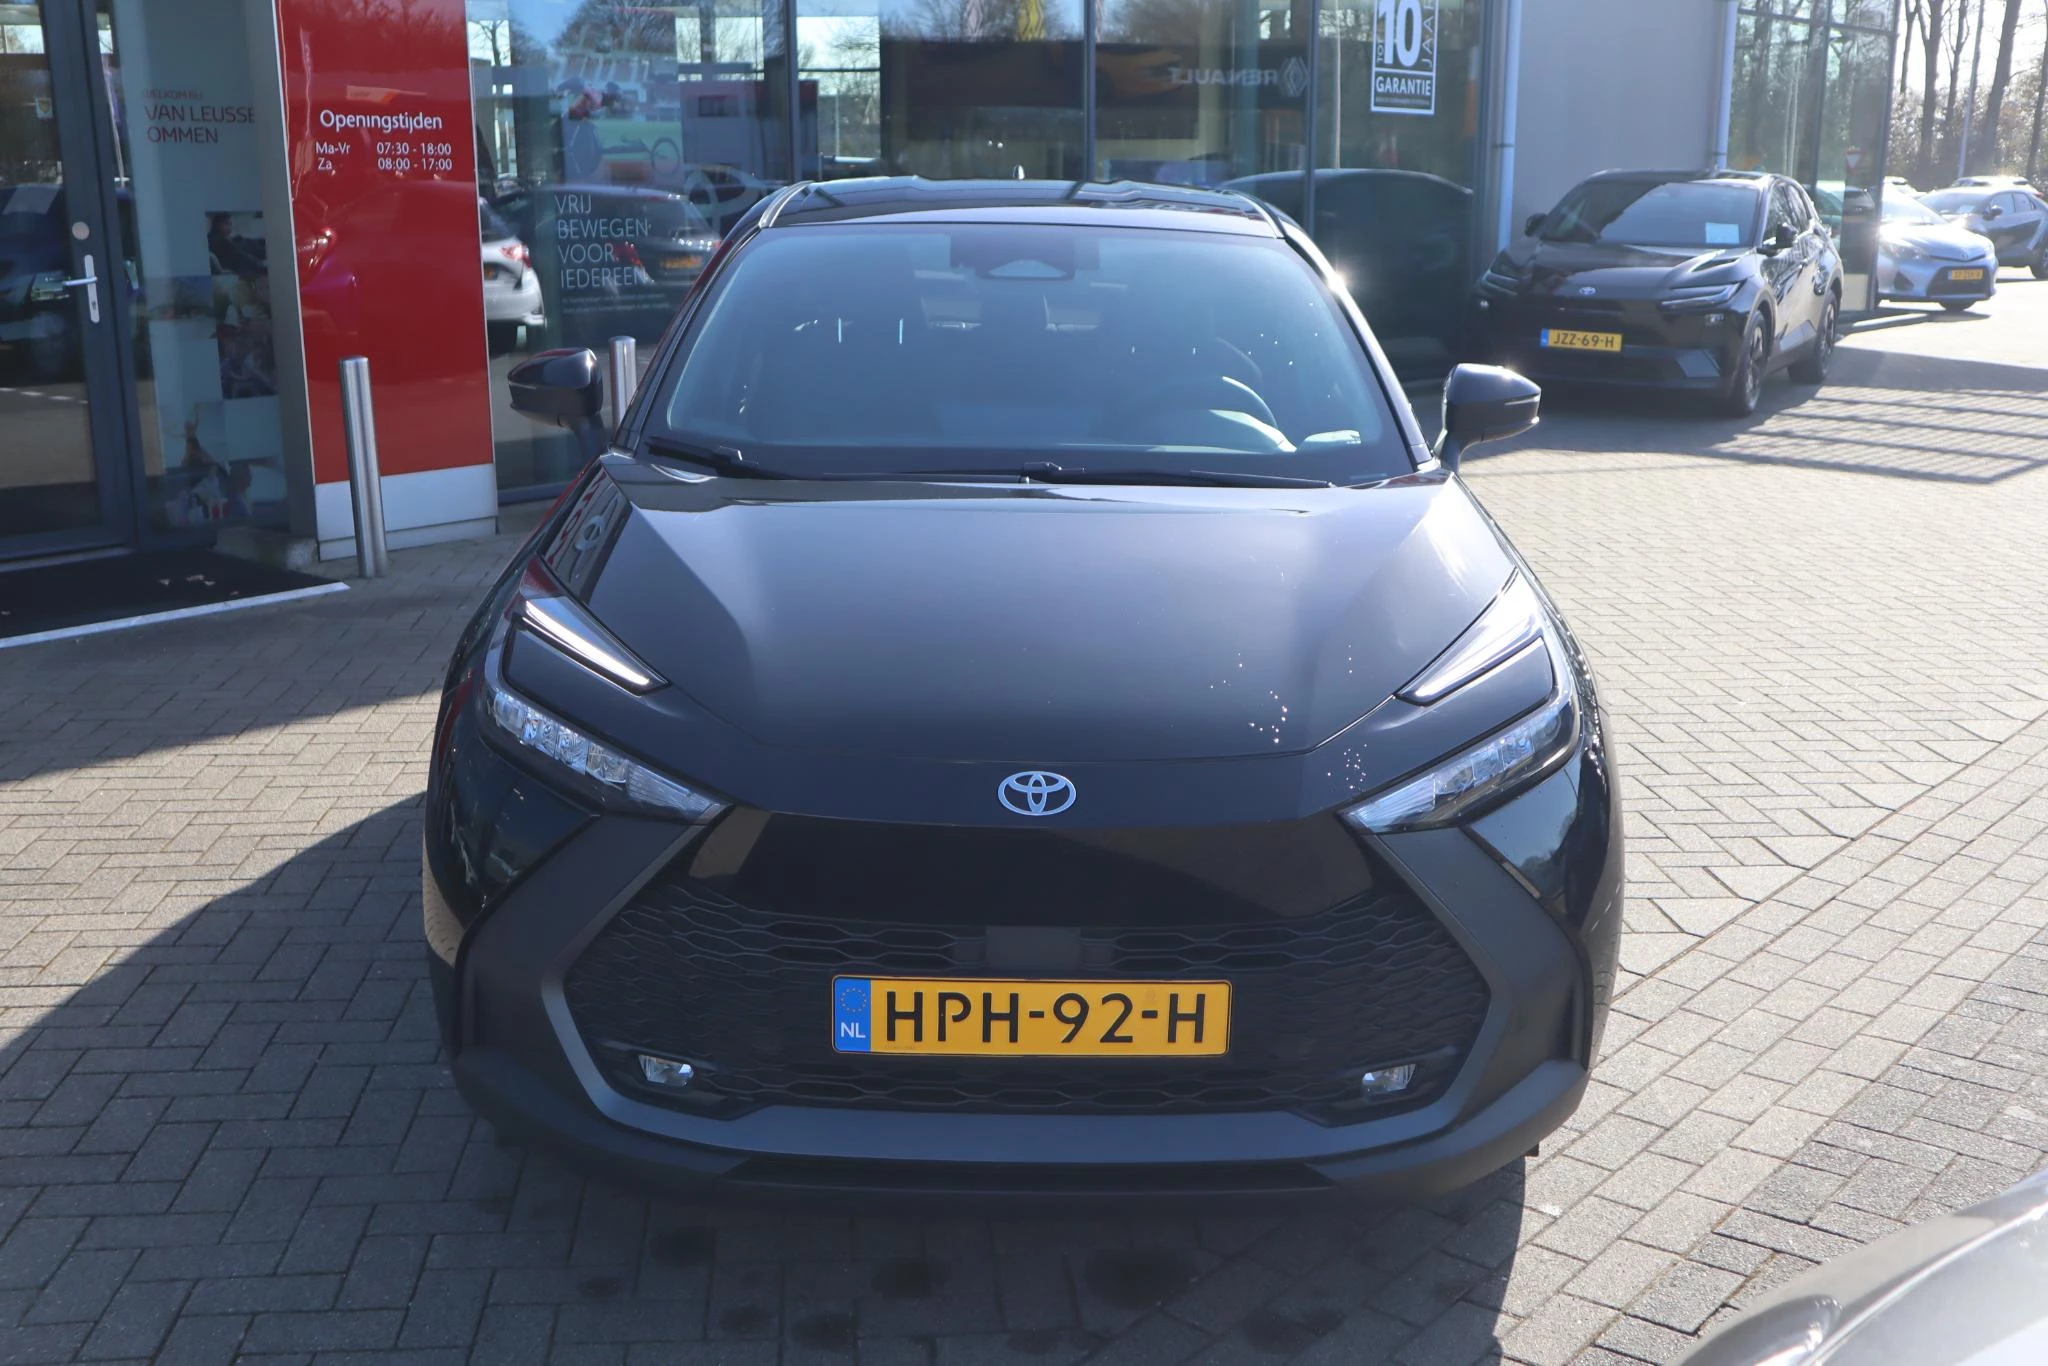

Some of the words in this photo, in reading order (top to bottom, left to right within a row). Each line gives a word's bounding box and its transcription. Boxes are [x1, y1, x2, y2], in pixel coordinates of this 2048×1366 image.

[1378, 0, 1422, 67] 10
[1376, 76, 1431, 96] GARANTIE
[145, 104, 185, 121] VAN
[320, 109, 443, 133] Openingstijden
[147, 126, 218, 143] OMMEN
[315, 142, 351, 154] Ma-Vr
[377, 142, 410, 154] 07:30
[421, 143, 452, 155] 18:00
[377, 158, 411, 170] 08:00
[421, 158, 453, 170] 17:00
[555, 194, 592, 214] VRIJ
[558, 218, 649, 239] BEWEGEN
[558, 243, 616, 264] VOOR
[561, 266, 648, 288] IEDEREEN
[1553, 332, 1615, 348] JZZ-69-H
[886, 991, 1206, 1044] HPH-92-H
[841, 1022, 866, 1039] NL
